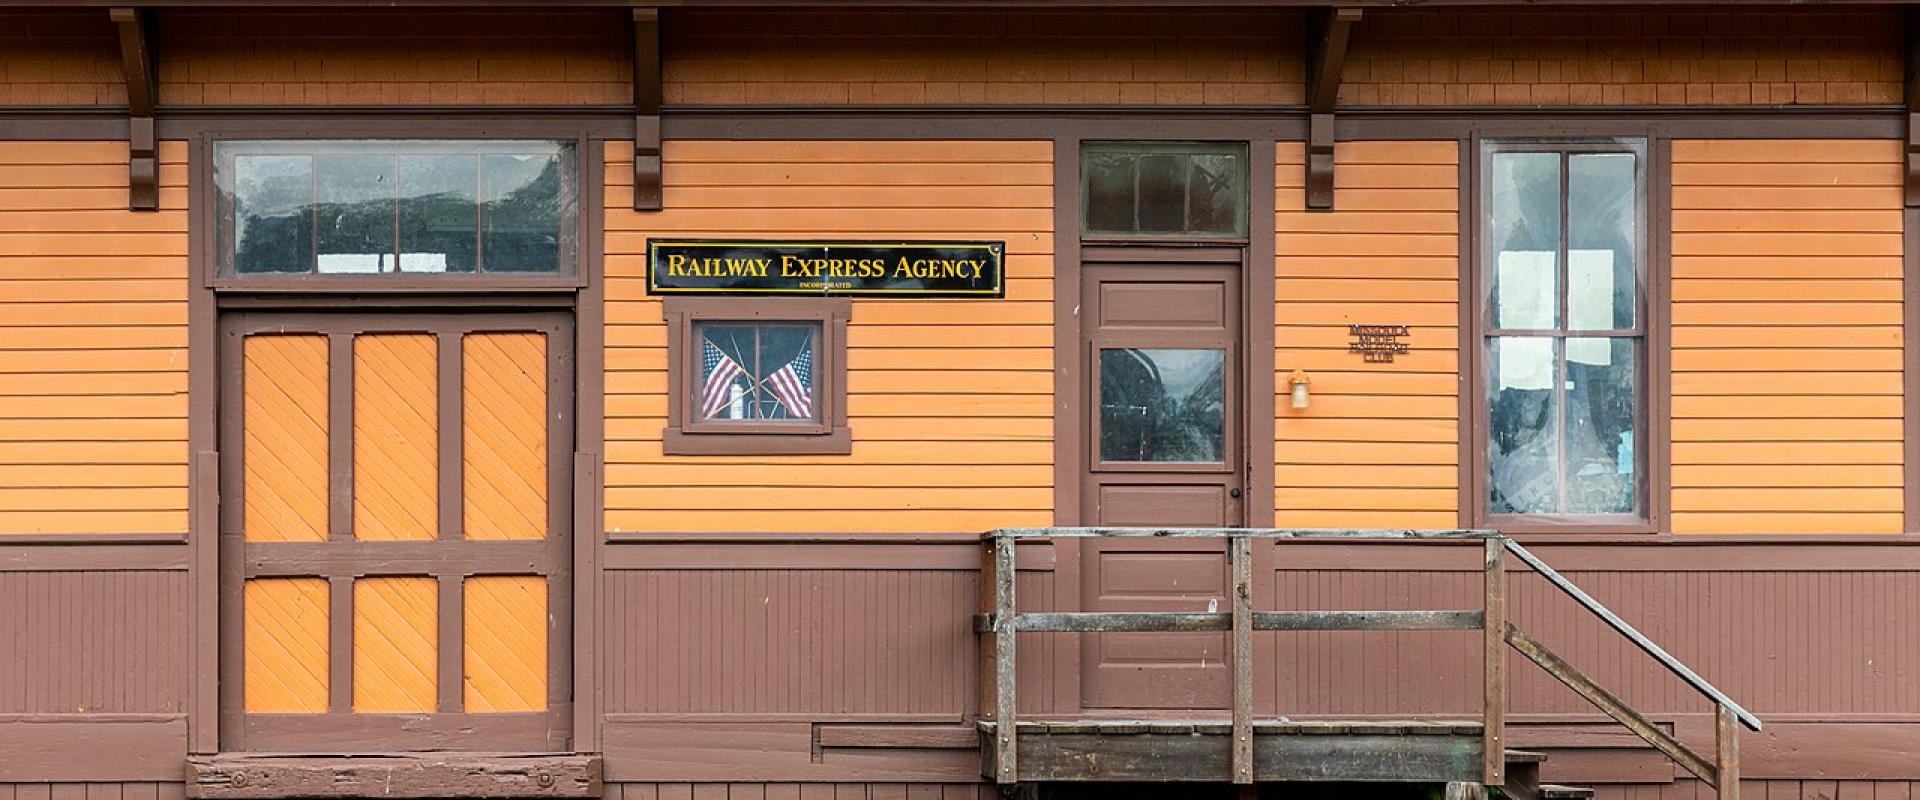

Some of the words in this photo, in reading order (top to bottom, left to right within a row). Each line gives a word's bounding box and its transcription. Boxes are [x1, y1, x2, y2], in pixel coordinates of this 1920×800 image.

[668, 254, 772, 277] RAILWAY
[781, 255, 885, 278] EXPRESS
[893, 256, 986, 279] AGENCY
